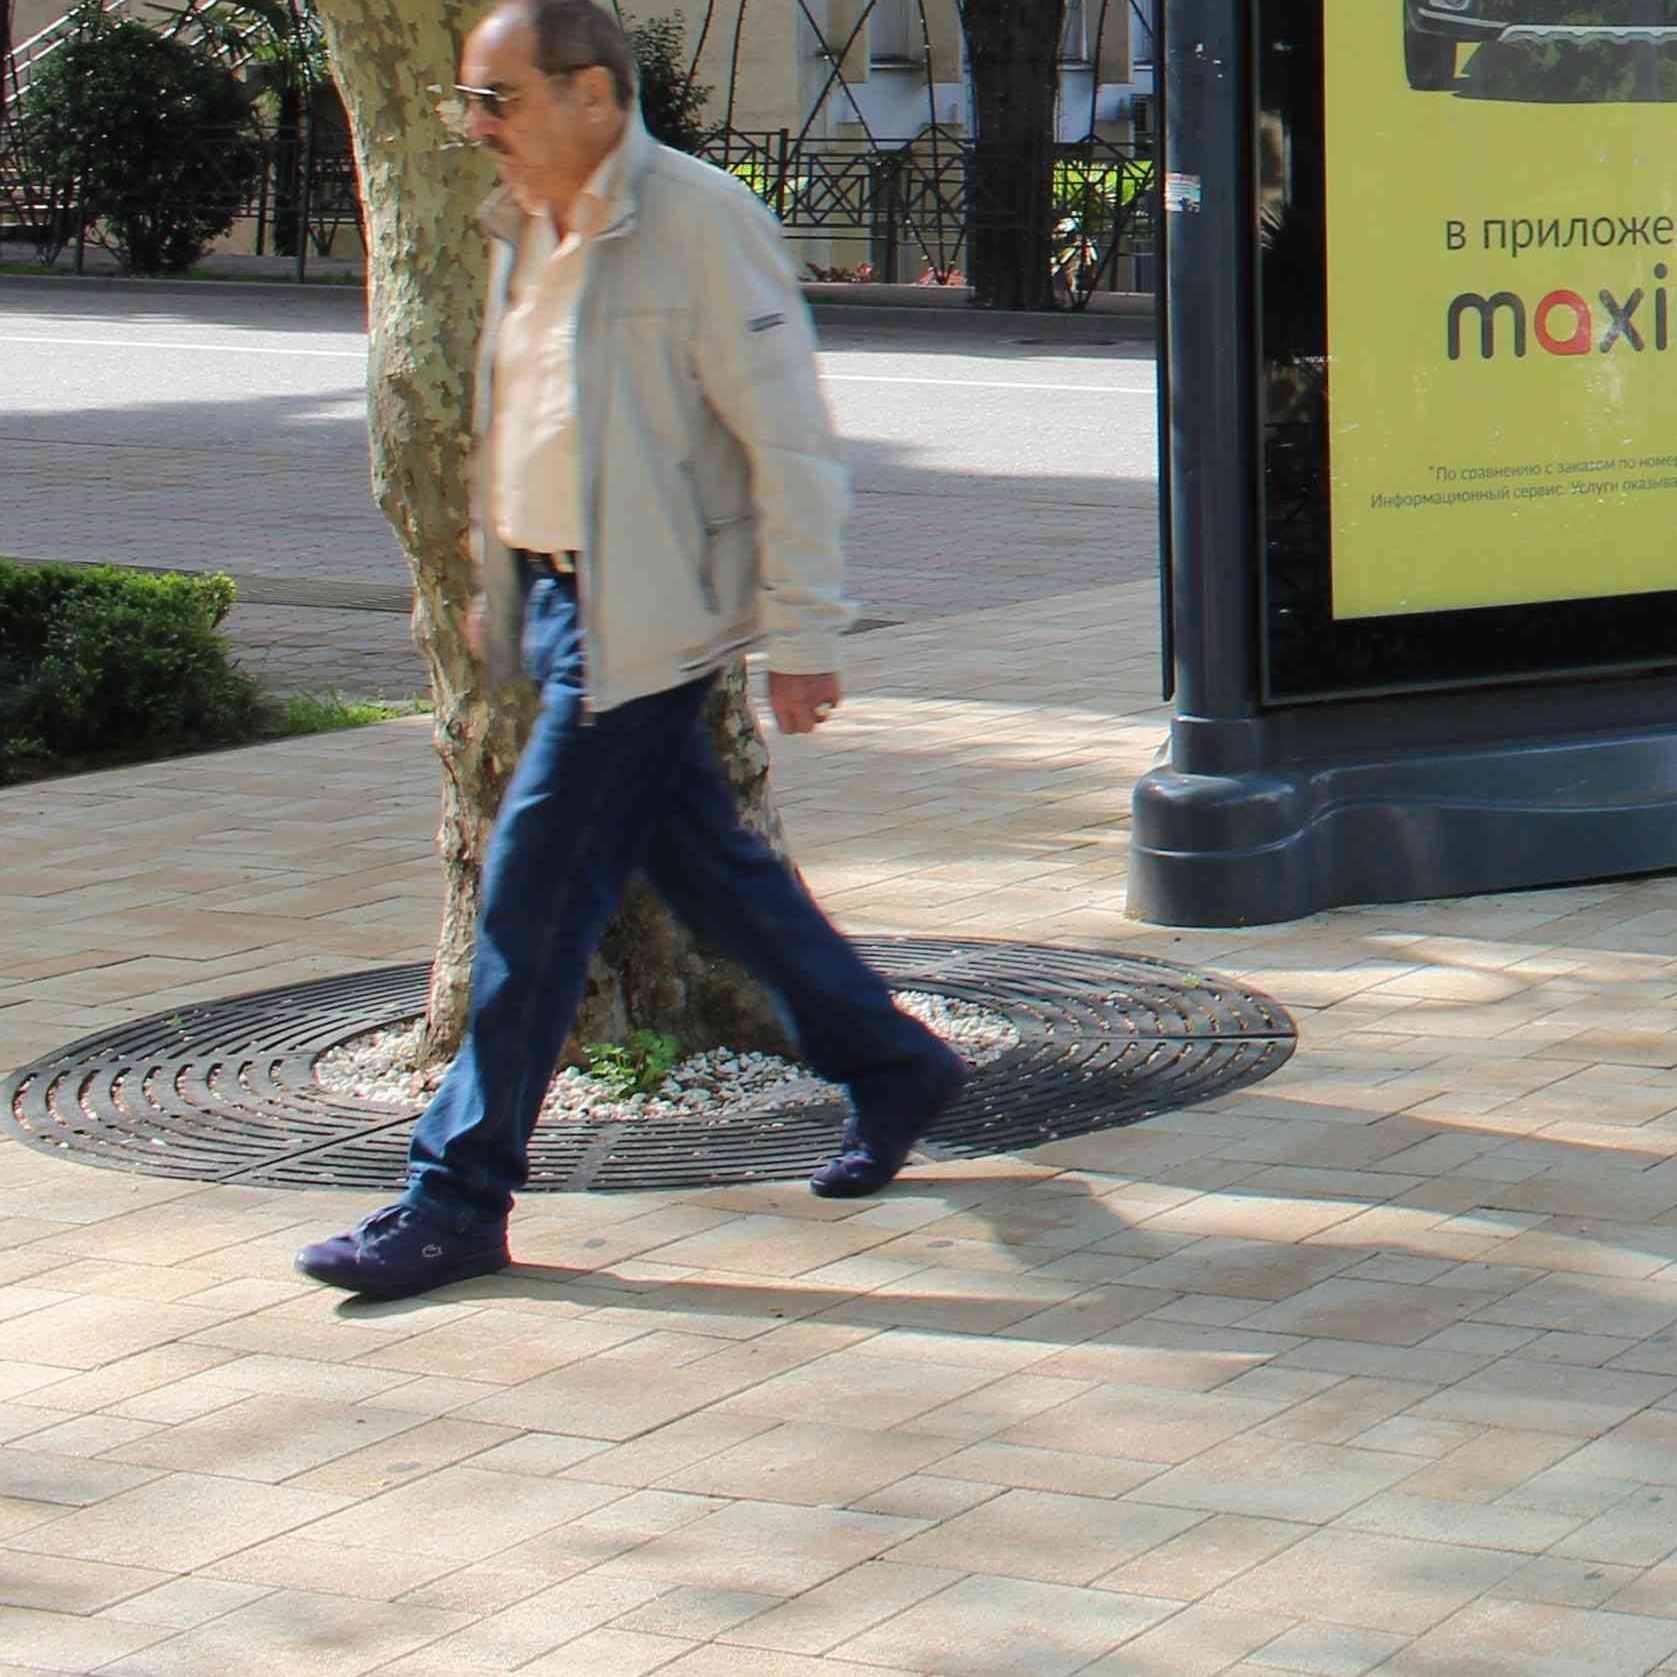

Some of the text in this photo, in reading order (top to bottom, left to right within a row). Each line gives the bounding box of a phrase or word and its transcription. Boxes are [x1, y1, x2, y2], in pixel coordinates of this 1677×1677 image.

[1447, 220, 1467, 250] в
[1461, 463, 1540, 482] сравнению
[1545, 465, 1552, 475] с
[1618, 459, 1634, 470] по
[1371, 485, 1510, 510] Информационный
